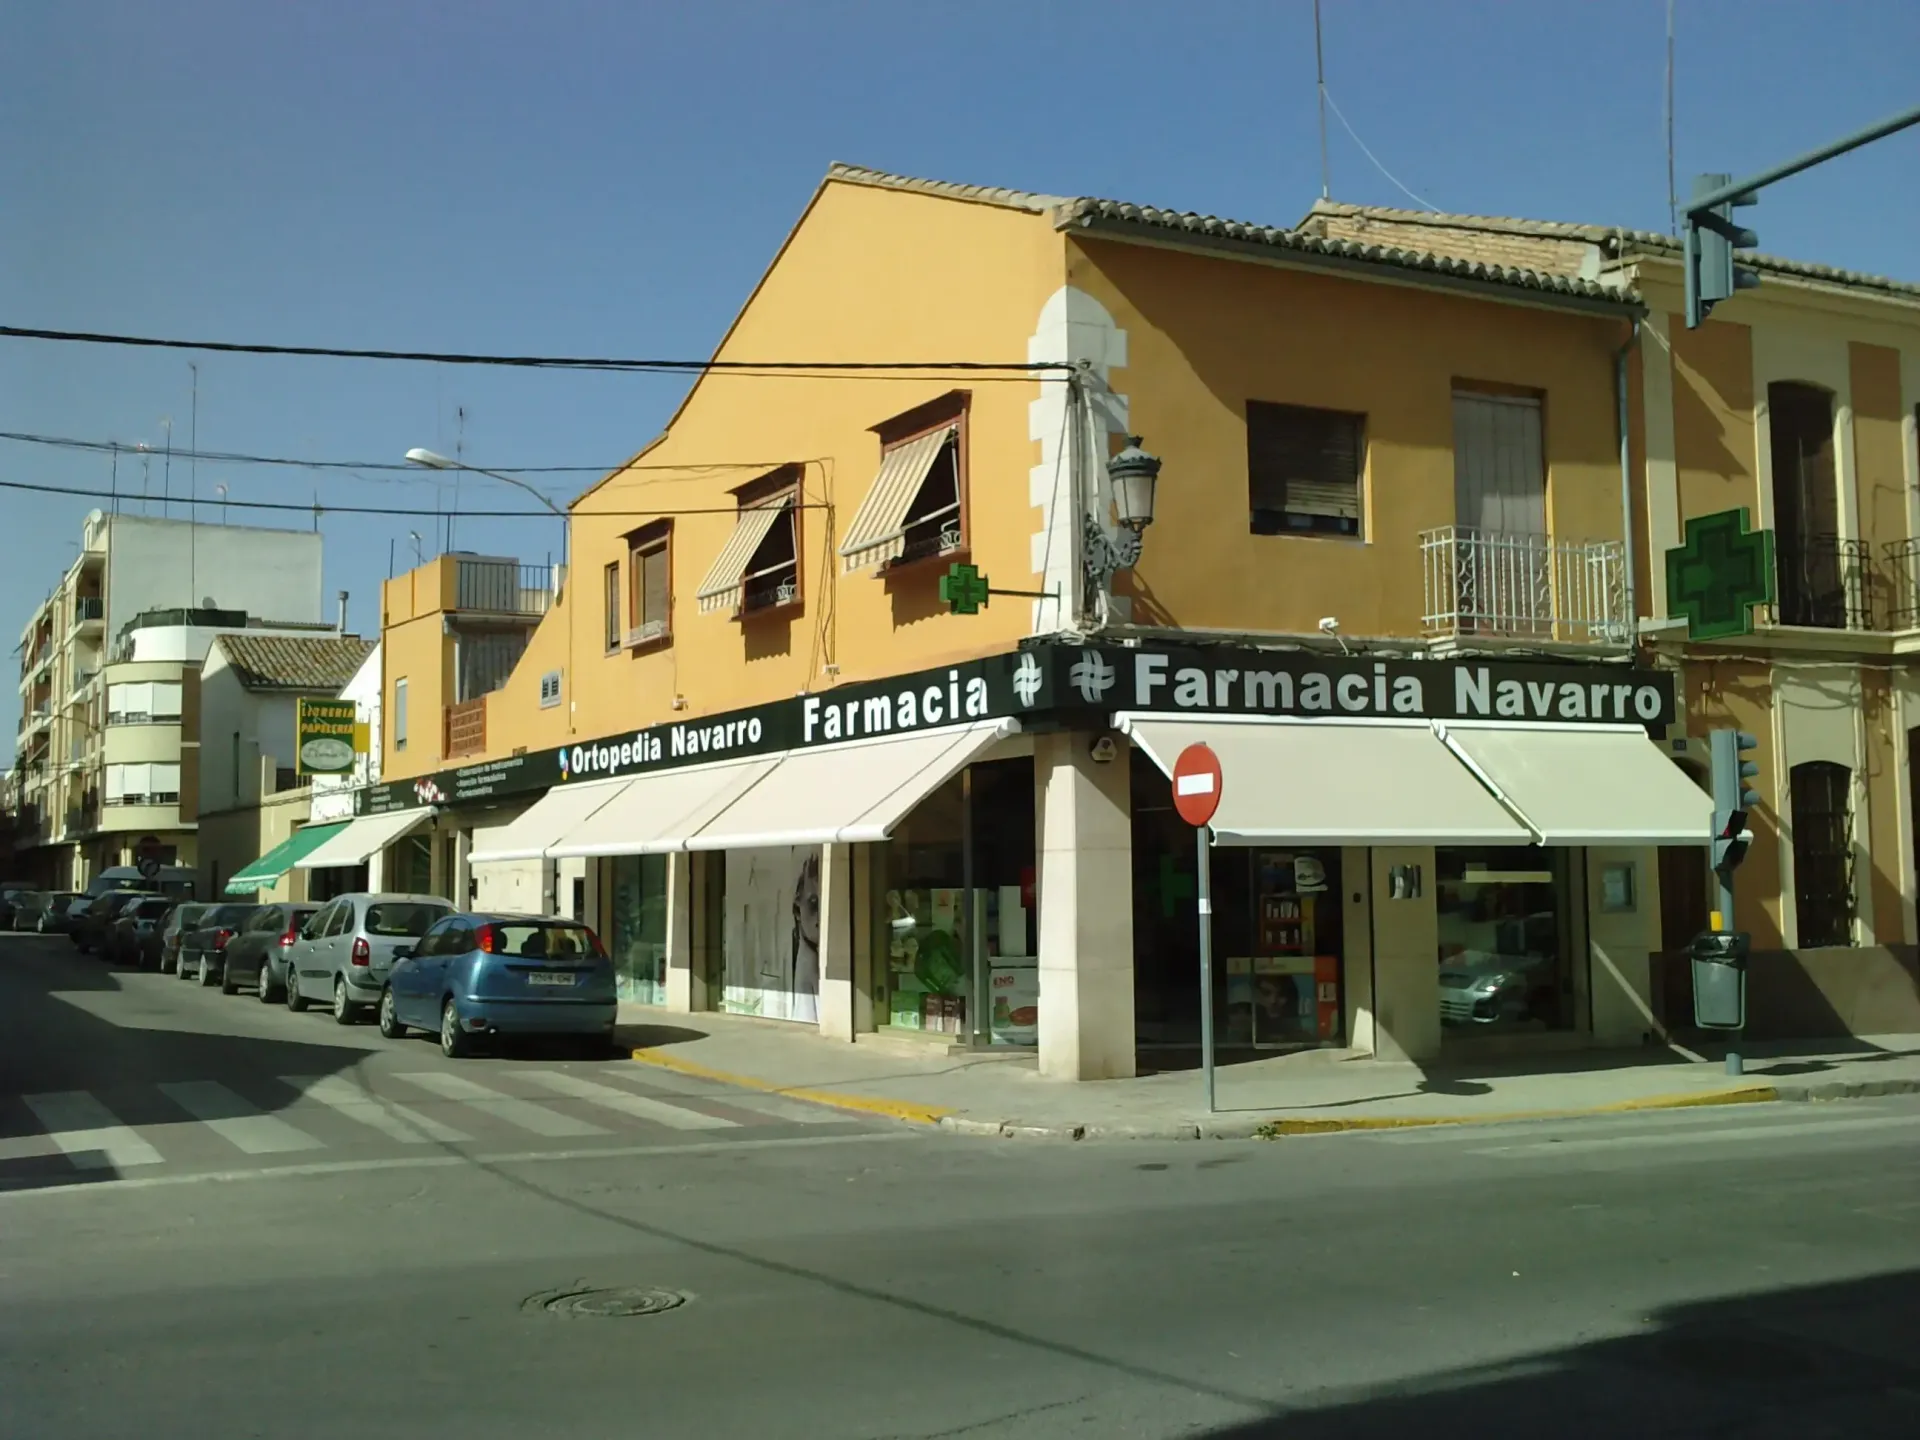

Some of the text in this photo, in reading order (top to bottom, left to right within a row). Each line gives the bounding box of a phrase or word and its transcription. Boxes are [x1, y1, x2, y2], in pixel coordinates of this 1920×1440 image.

[803, 669, 988, 743] Farmacia
[1134, 653, 1662, 720] Farmacia Navarro
[571, 717, 762, 774] Ortopedia Navarro
